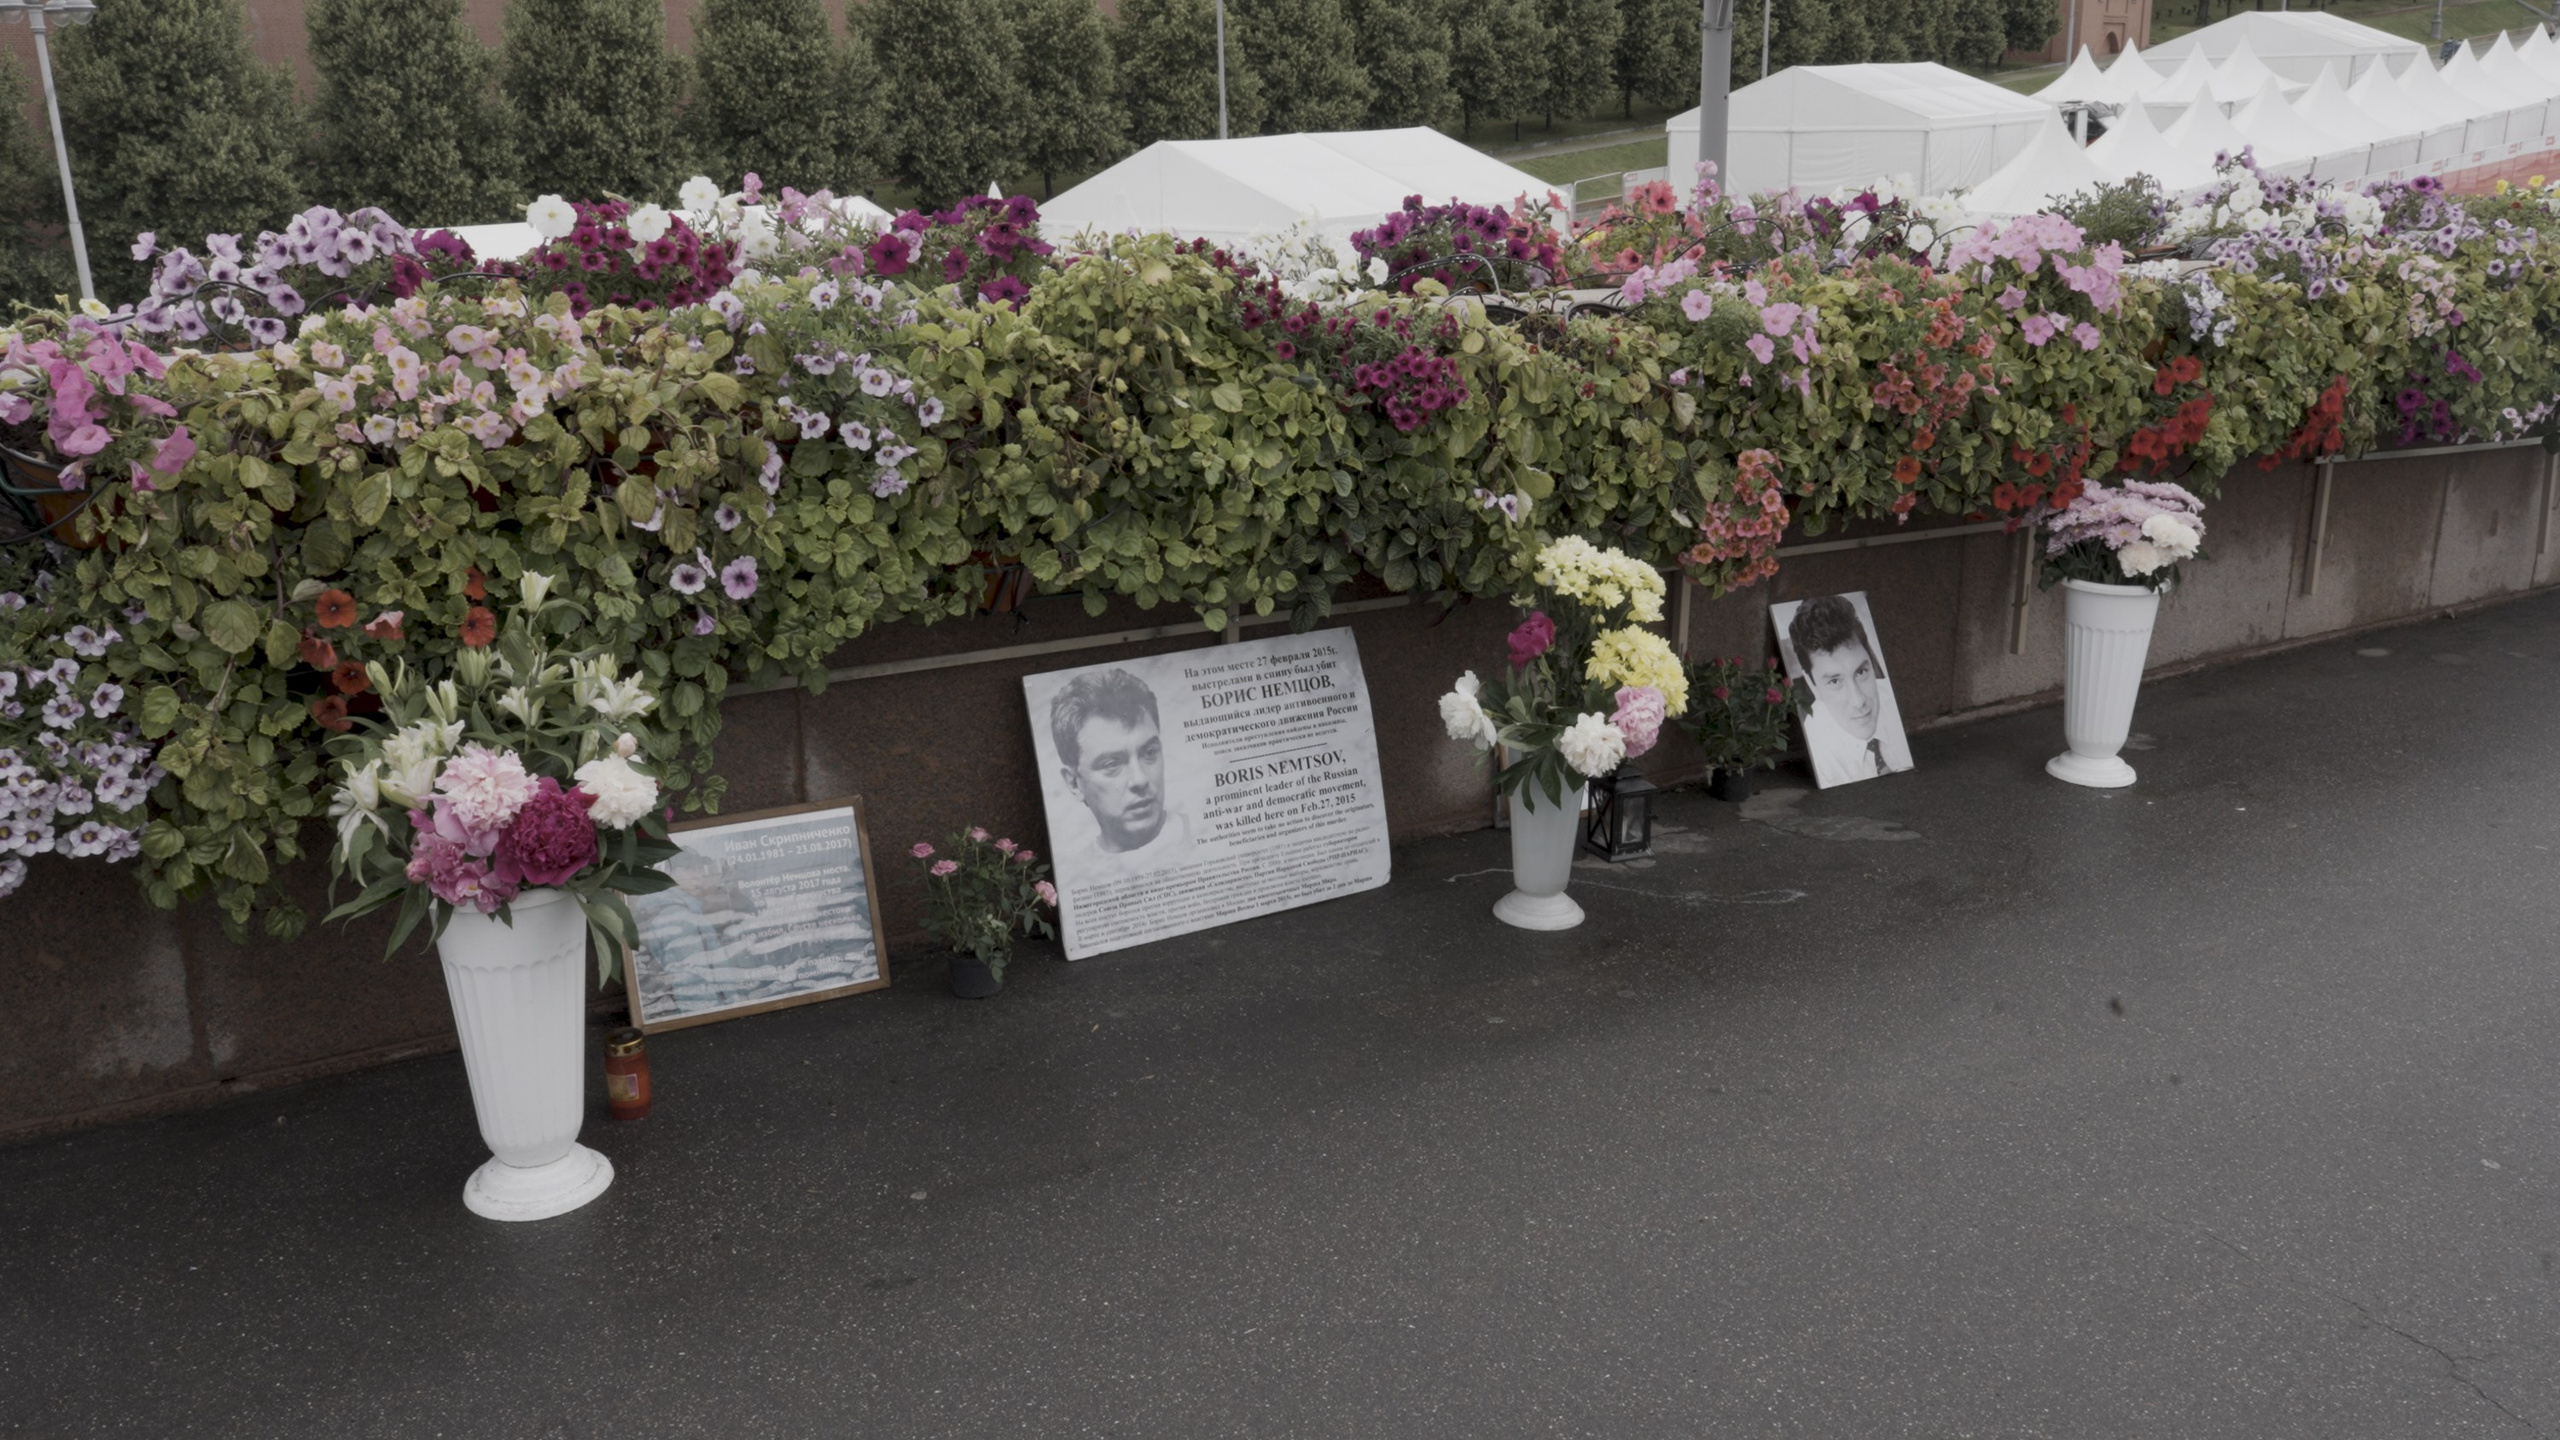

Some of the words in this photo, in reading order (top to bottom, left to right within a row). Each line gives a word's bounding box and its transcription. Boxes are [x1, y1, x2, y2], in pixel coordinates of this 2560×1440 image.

[1184, 668, 1199, 679] На
[1201, 665, 1224, 676] этом
[1227, 661, 1255, 672] месте
[1257, 655, 1268, 667] 27
[1270, 652, 1311, 667] февраля
[1312, 645, 1338, 658] 2015г.
[1192, 675, 1253, 692] выстрелами
[1255, 673, 1262, 681] в
[1264, 668, 1292, 680] спину
[1294, 664, 1314, 675] был
[1316, 660, 1337, 674] убит
[1201, 686, 1257, 709] БОРИС
[1262, 674, 1335, 699] НЕМЦОВ,
[1183, 709, 1251, 728] выдающийся
[1252, 704, 1282, 716] лидер
[1284, 693, 1348, 711] антивоенного
[1349, 691, 1356, 699] и
[1185, 719, 1276, 744] демократического
[1278, 710, 1324, 727] движения
[1326, 704, 1358, 717] России
[1215, 765, 1264, 787] BORIS
[1268, 750, 1347, 777] NEMTSOV,
[1203, 805, 1244, 820] anti-war
[1246, 798, 1264, 811] and
[1265, 788, 1316, 807] democratic
[1319, 777, 1367, 796] movement,
[1205, 797, 1212, 805] a
[1214, 784, 1263, 806] prominent
[1264, 780, 1294, 793] leader
[1296, 775, 1306, 787] of
[1307, 773, 1322, 784] the
[1324, 767, 1358, 781] Russian
[1197, 837, 1208, 845] The
[1209, 831, 1240, 843] authorities
[1241, 828, 1256, 836] seem
[1264, 823, 1276, 831] take
[1286, 817, 1304, 826] action
[1311, 811, 1334, 821] discover
[1334, 808, 1343, 816] the
[1216, 821, 1234, 831] was
[1235, 812, 1262, 827] killed
[1264, 810, 1285, 821] here
[1287, 807, 1298, 816] on
[1301, 798, 1334, 813] Feb.27,
[1335, 792, 1356, 806] 2015
[724, 839, 757, 853] Иван
[761, 826, 851, 848] Скрипниченко
[1229, 834, 1265, 847] beneficiaries
[1266, 831, 1277, 839] and
[1278, 826, 1308, 837] organizers
[1308, 822, 1315, 830] of
[727, 847, 785, 868] (24.01.1981
[796, 837, 852, 855] 23.08.2017)
[738, 874, 781, 890] Волонтёр
[782, 870, 821, 882] Немцова
[823, 865, 851, 876] моста.
[751, 888, 761, 898] 15
[764, 884, 796, 896] августа
[799, 878, 820, 890] 2017
[822, 877, 841, 886] года
